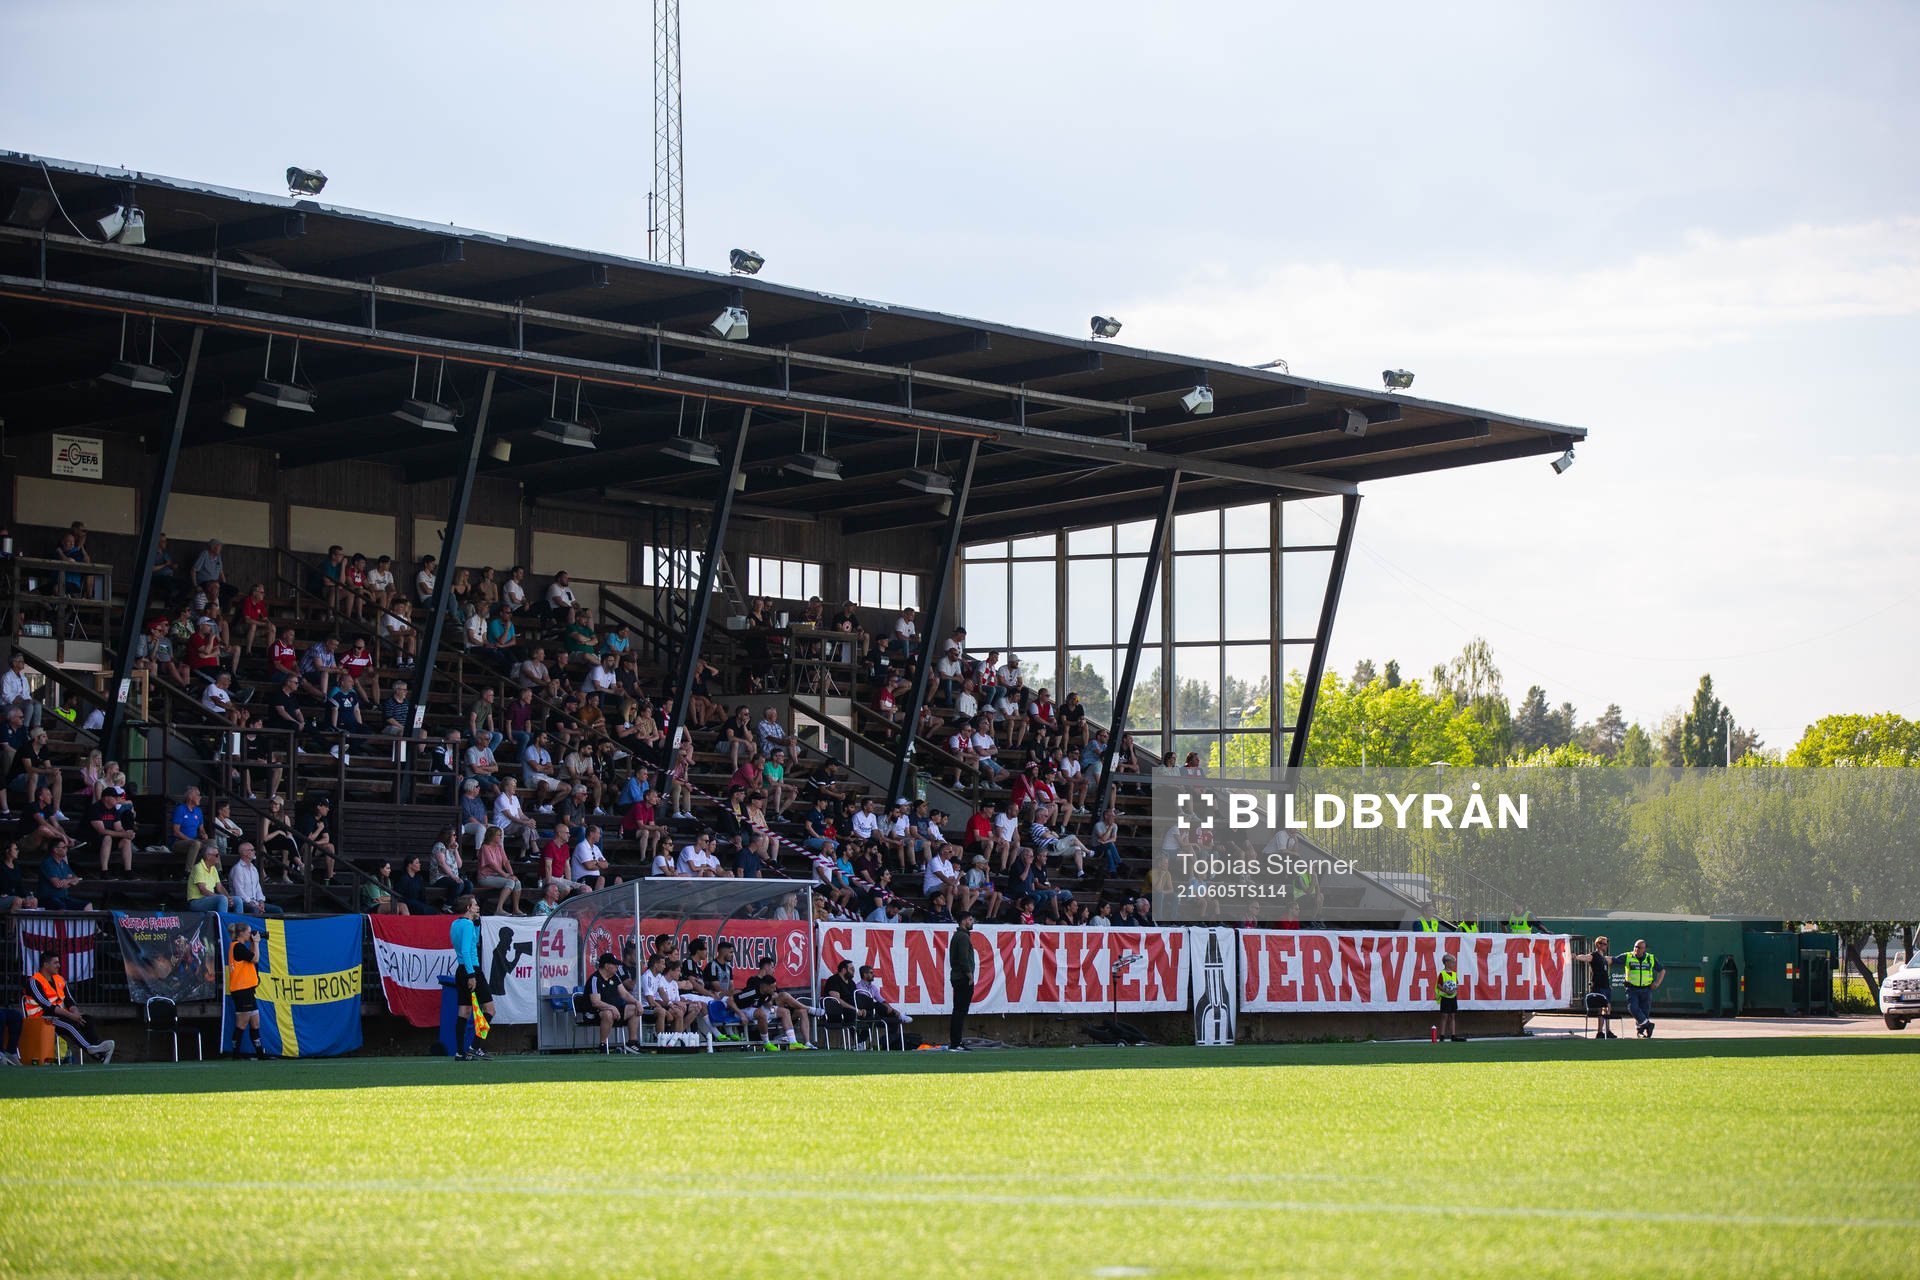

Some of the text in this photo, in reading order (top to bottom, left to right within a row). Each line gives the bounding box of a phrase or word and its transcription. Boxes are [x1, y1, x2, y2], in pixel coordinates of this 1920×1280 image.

[271, 970, 358, 1000] THE IRONS
[515, 965, 533, 978] HIT
[820, 927, 1183, 1004] SANDVIKEN
[1243, 934, 1566, 1003] JERNVALLEN
